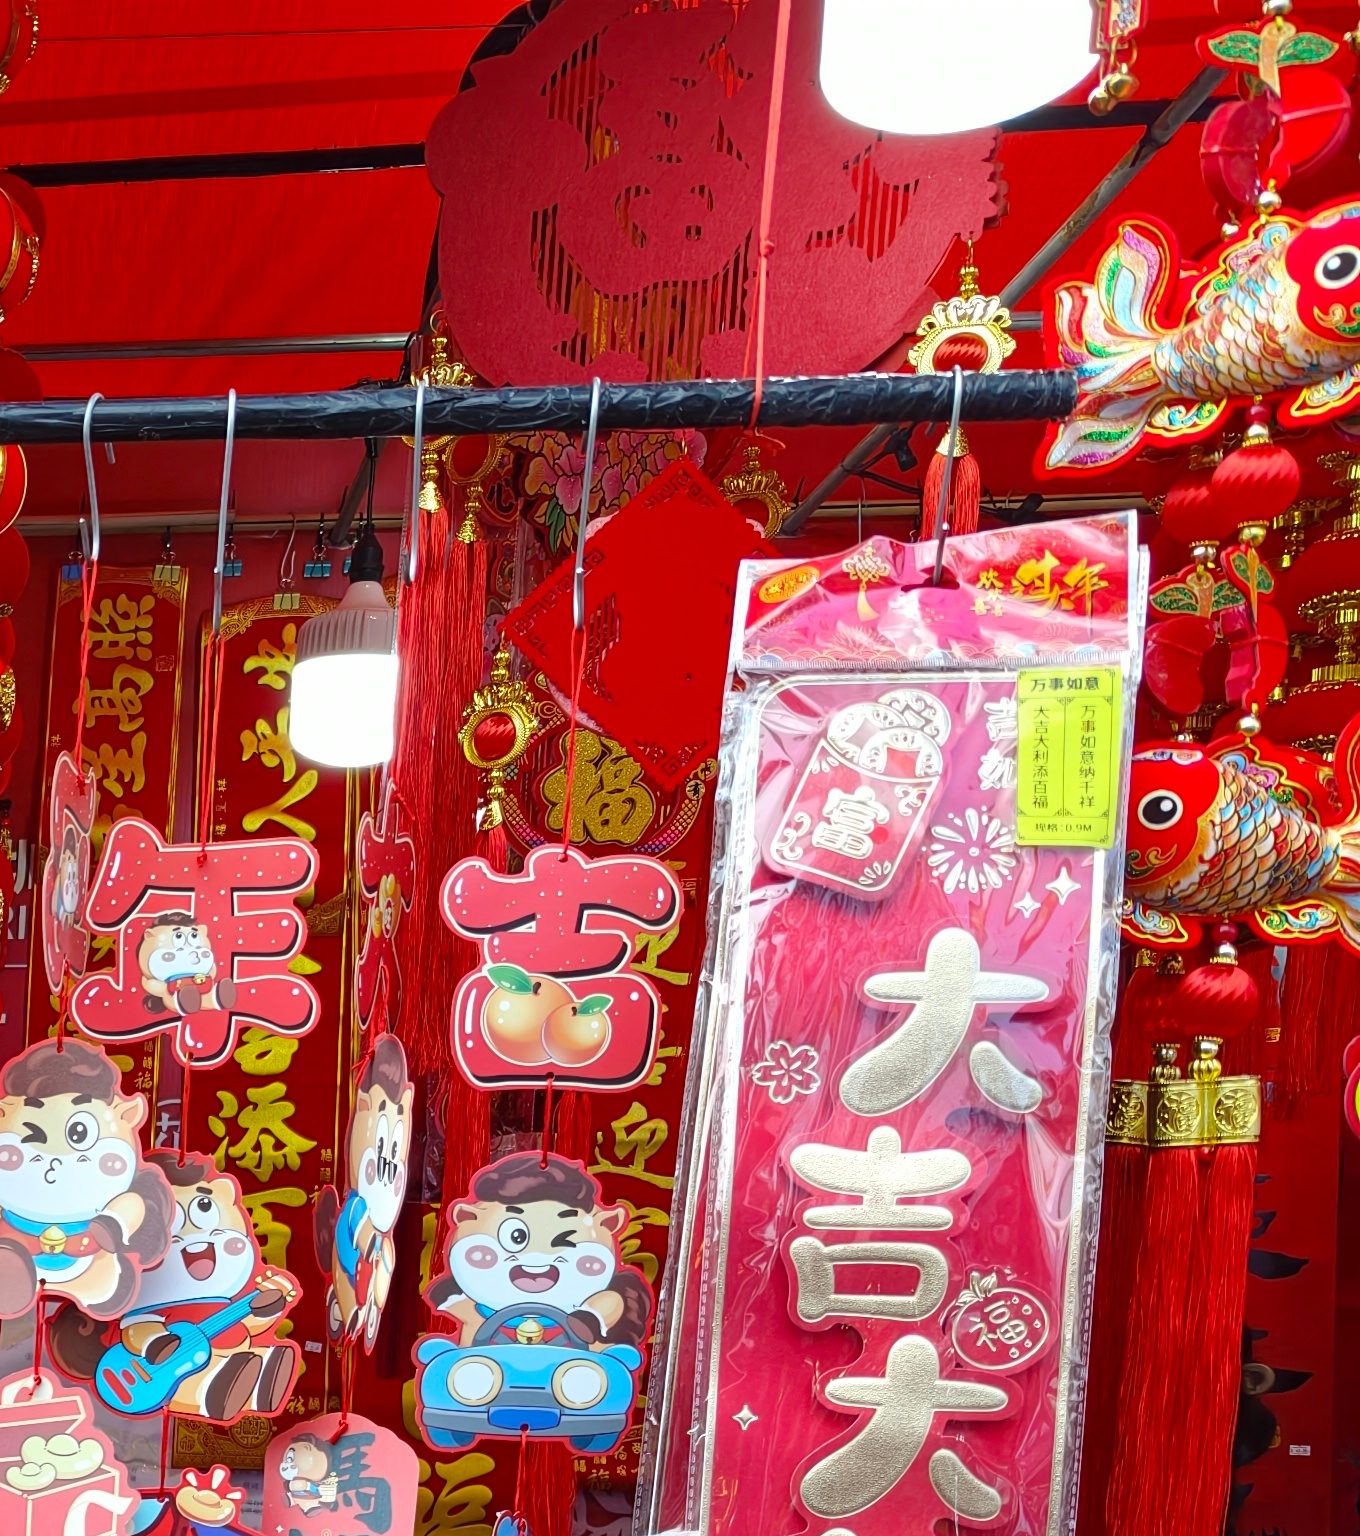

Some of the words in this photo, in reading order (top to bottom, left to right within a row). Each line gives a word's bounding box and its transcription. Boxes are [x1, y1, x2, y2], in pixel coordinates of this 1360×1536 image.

[1030, 675, 1100, 693] 万事如意
[544, 730, 657, 846] 福
[1032, 704, 1050, 810] 大吉大利添百福
[1079, 704, 1097, 810] 万事如意纳千祥
[811, 786, 889, 860] 富
[74, 820, 318, 1066] 年
